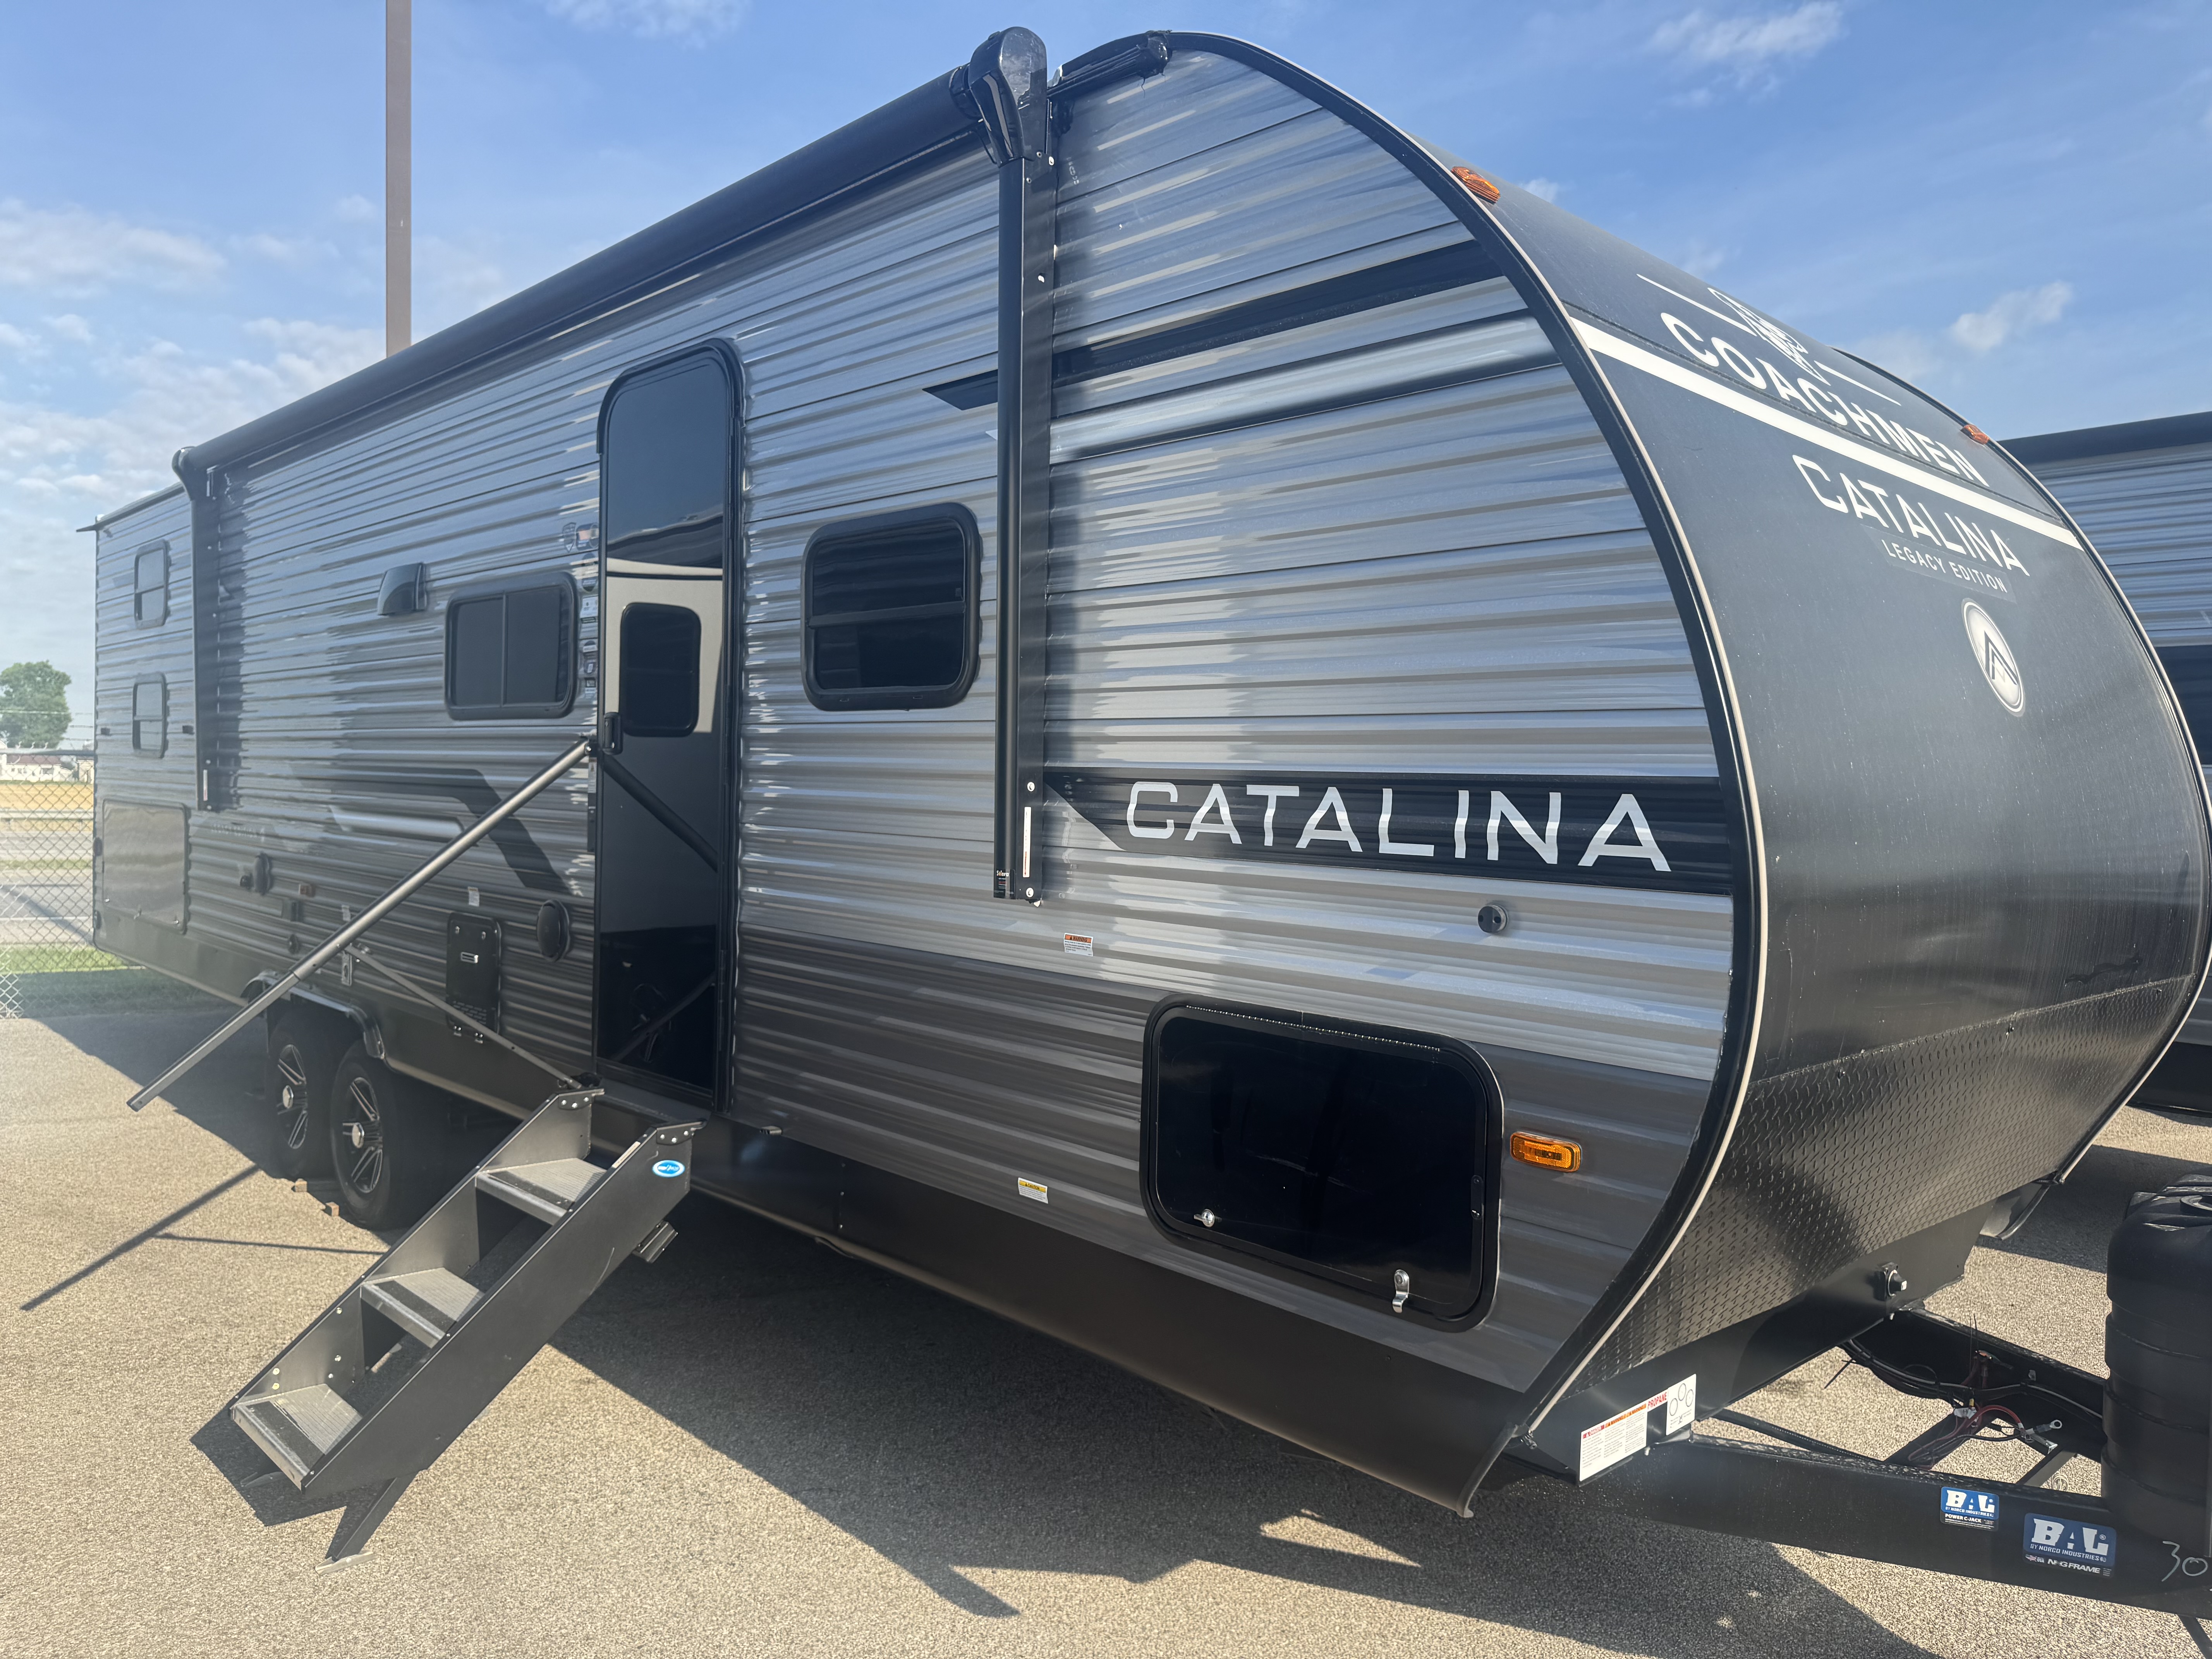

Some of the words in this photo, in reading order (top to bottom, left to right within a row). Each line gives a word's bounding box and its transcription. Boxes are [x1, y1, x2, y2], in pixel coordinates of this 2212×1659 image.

[1661, 313, 1990, 487] COACHMEN
[1792, 455, 2030, 577] CATALINA
[1881, 539, 1946, 574] LEGACY
[1948, 561, 2008, 593] EDITION
[1126, 781, 1671, 872] CATALINA
[1946, 1490, 1995, 1513] BAL
[2031, 1518, 2109, 1556] BAL
[2039, 1545, 2061, 1554] NORCO
[2062, 1549, 2100, 1561] INDUSTRIES
[2068, 1562, 2101, 1574] FRAME
